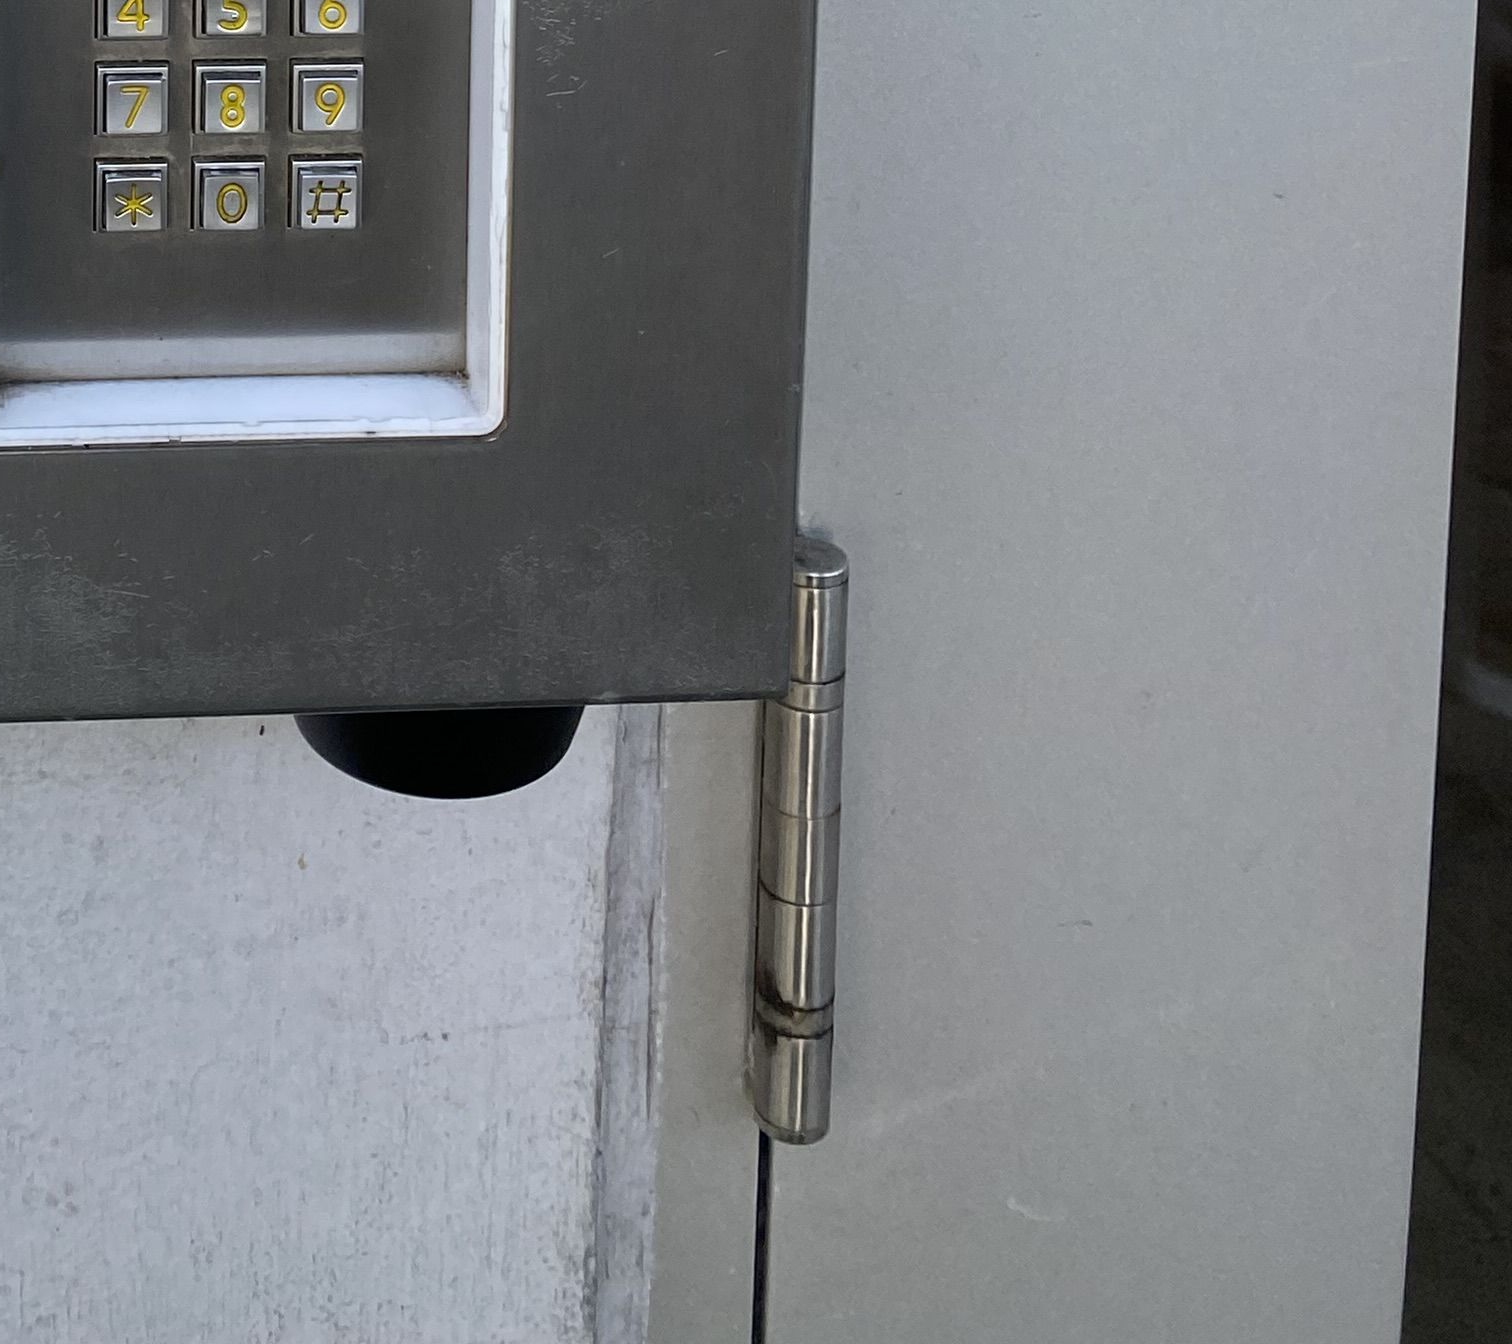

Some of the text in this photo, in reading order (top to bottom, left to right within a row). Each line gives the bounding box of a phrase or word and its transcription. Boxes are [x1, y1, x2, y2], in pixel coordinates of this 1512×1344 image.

[119, 82, 345, 128] 7 8 9
[306, 179, 353, 224] #
